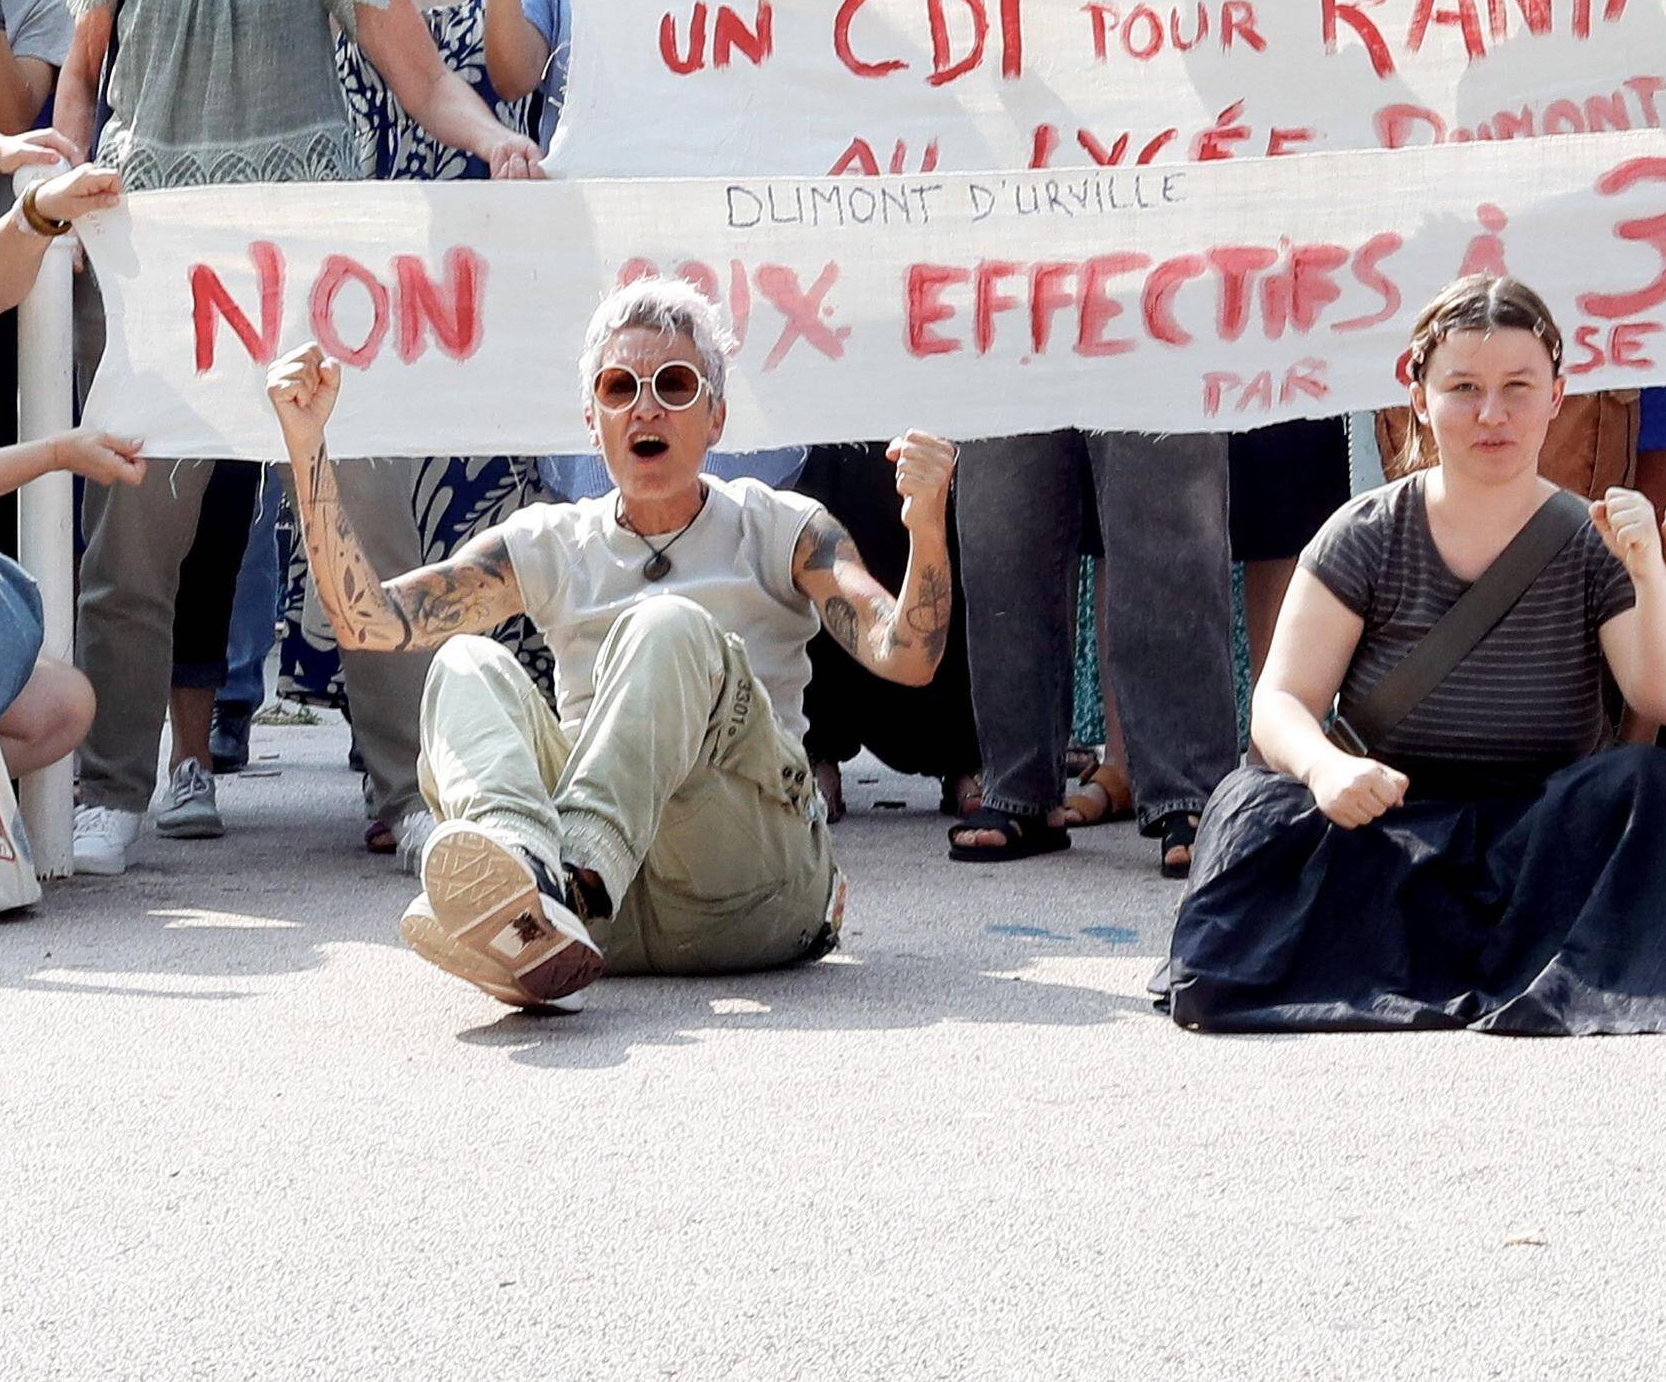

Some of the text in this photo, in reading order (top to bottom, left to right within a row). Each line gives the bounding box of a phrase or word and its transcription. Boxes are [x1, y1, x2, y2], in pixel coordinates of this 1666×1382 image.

[1078, 0, 1269, 63] POUR
[726, 184, 942, 228] DUMONT
[189, 240, 488, 375] NON
[1203, 358, 1331, 417] PAR
